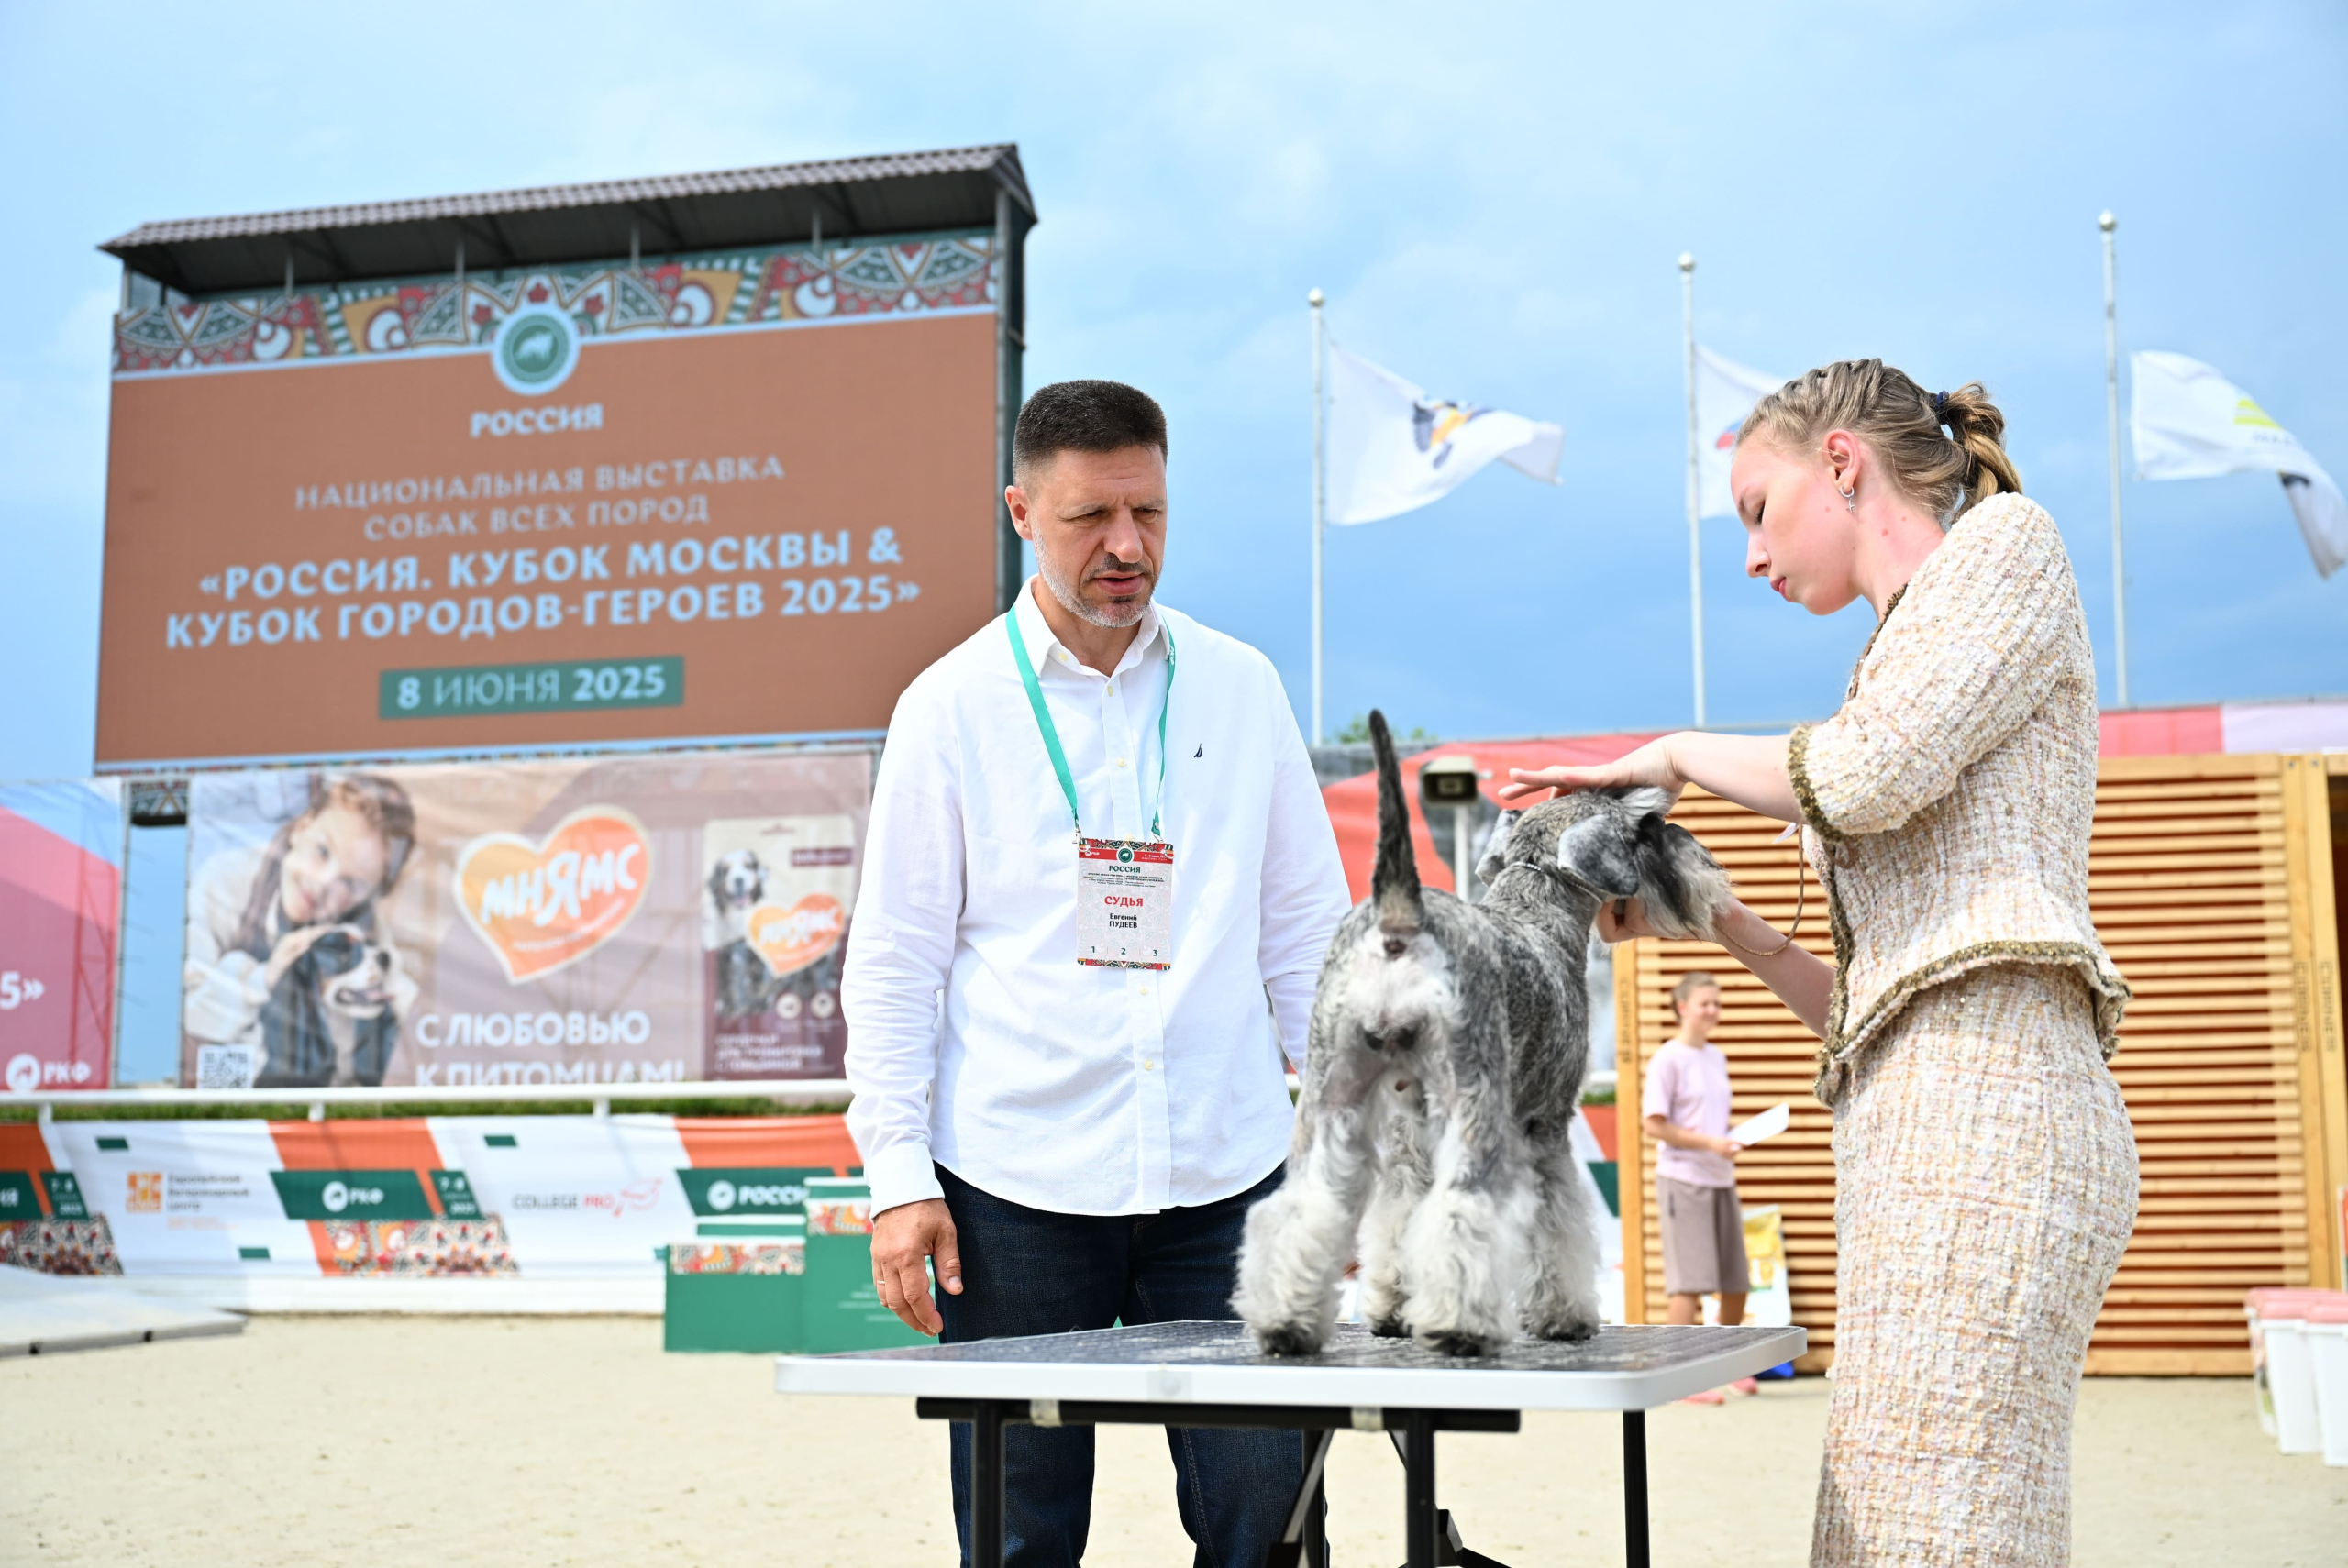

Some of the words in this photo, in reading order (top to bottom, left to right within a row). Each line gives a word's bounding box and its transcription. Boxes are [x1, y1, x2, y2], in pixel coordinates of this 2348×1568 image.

[470, 403, 604, 438] РОССИЯ
[295, 467, 584, 510] НАЦИОНАЛЬНАЯ
[596, 455, 785, 491] ВЫСТАВКА
[364, 510, 478, 541] СОБАК
[489, 503, 575, 534] ВСЕХ
[587, 495, 710, 527] ПОРОД
[200, 556, 432, 601] «РОССИЯ.
[449, 545, 610, 587] КУБОК
[627, 531, 850, 576] МОСКВЫ
[868, 526, 902, 563] &
[167, 607, 321, 648] КУБОК
[338, 581, 764, 640] ГОРОДОВ-ГЕРОЕВ
[781, 574, 920, 615] 2025»
[398, 676, 421, 710] 8
[435, 669, 561, 707] ИЮНЯ
[573, 665, 666, 702] 2025
[1109, 865, 1140, 873] РОССИЯ
[481, 842, 640, 927] МНЯМС
[1104, 895, 1143, 908] СУДЬЯ
[1109, 912, 1137, 921] Евгений
[1109, 921, 1138, 929] ПУДЕЕВ
[416, 1013, 441, 1047] С
[445, 1010, 651, 1046] ЛЮБОВЬЮ
[43, 1060, 91, 1084] РКФ
[416, 1062, 440, 1086] К
[349, 1187, 384, 1205] РКФ
[511, 1194, 579, 1210] COLLEGE
[582, 1194, 615, 1209] PRO
[738, 1184, 808, 1206] РОССИ
